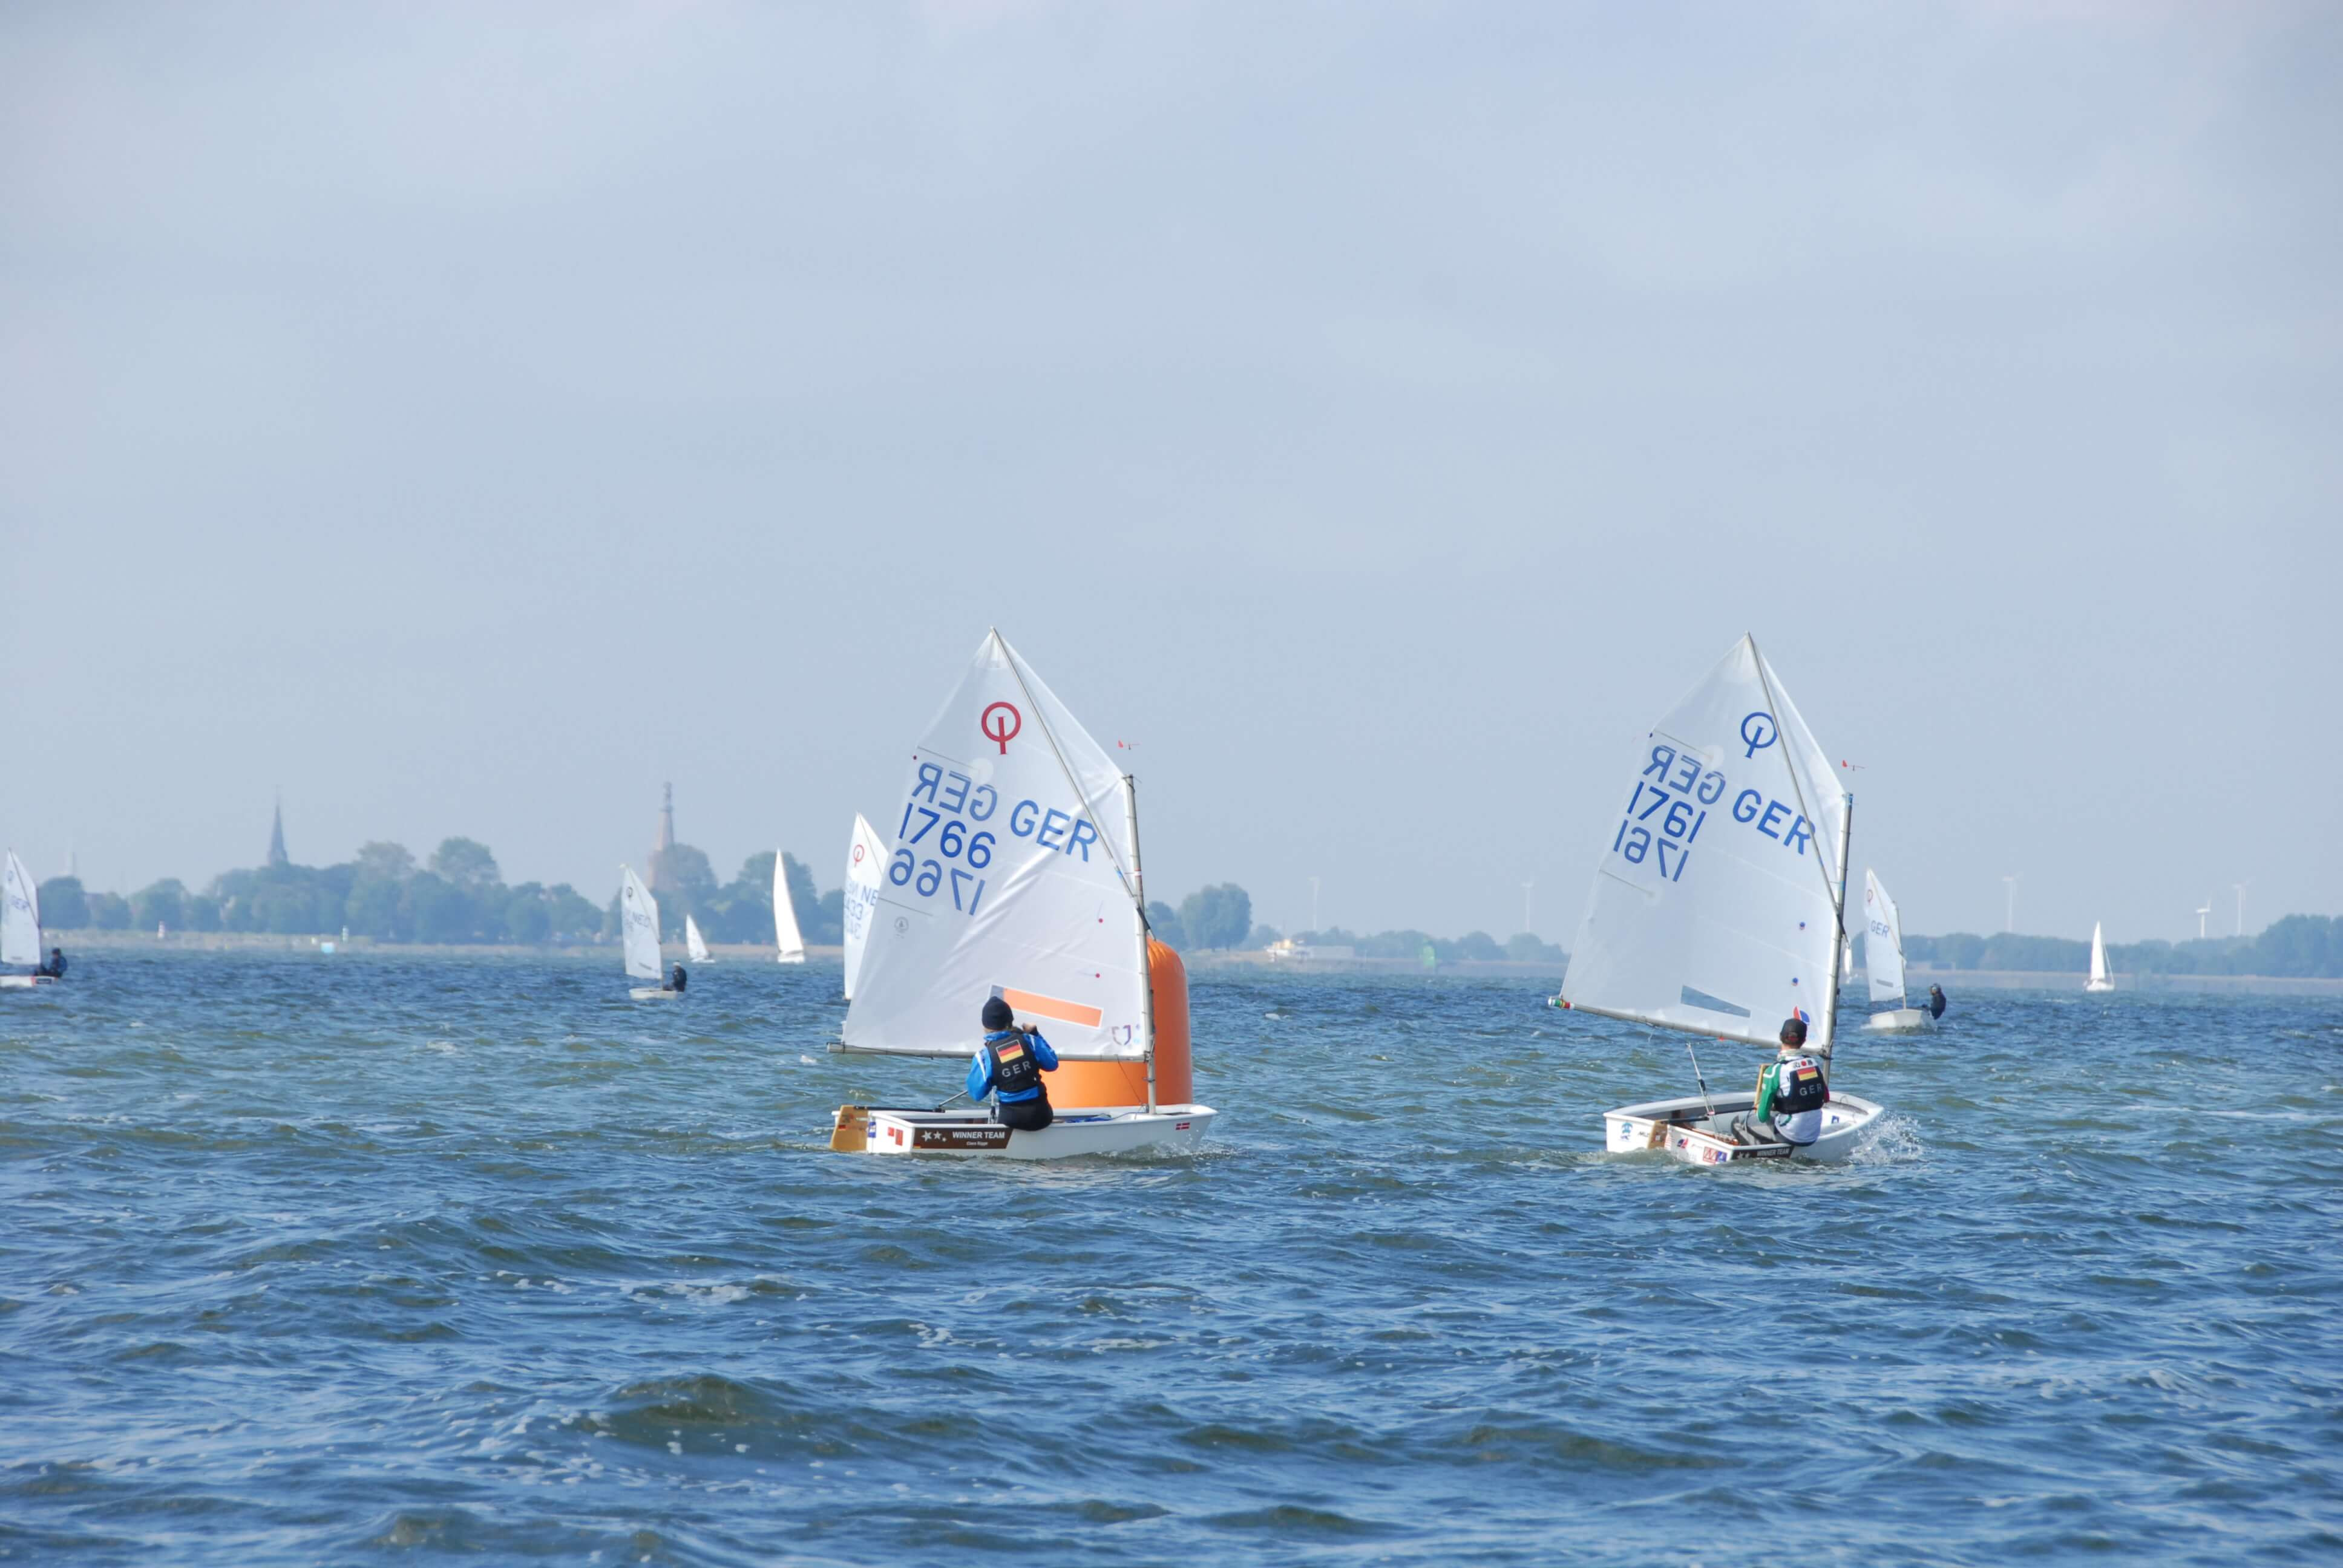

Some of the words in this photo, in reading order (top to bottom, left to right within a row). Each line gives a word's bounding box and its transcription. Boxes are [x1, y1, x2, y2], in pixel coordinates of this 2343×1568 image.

[1627, 780, 1706, 844] 1761
[1732, 789, 1816, 855] GER
[899, 803, 997, 869] 1766
[1009, 800, 1098, 863] GER
[861, 885, 879, 906] NE
[1870, 920, 1889, 938] GER
[1001, 1060, 1031, 1077] GER
[1800, 1083, 1822, 1096] GER
[952, 1131, 983, 1139] WINNER
